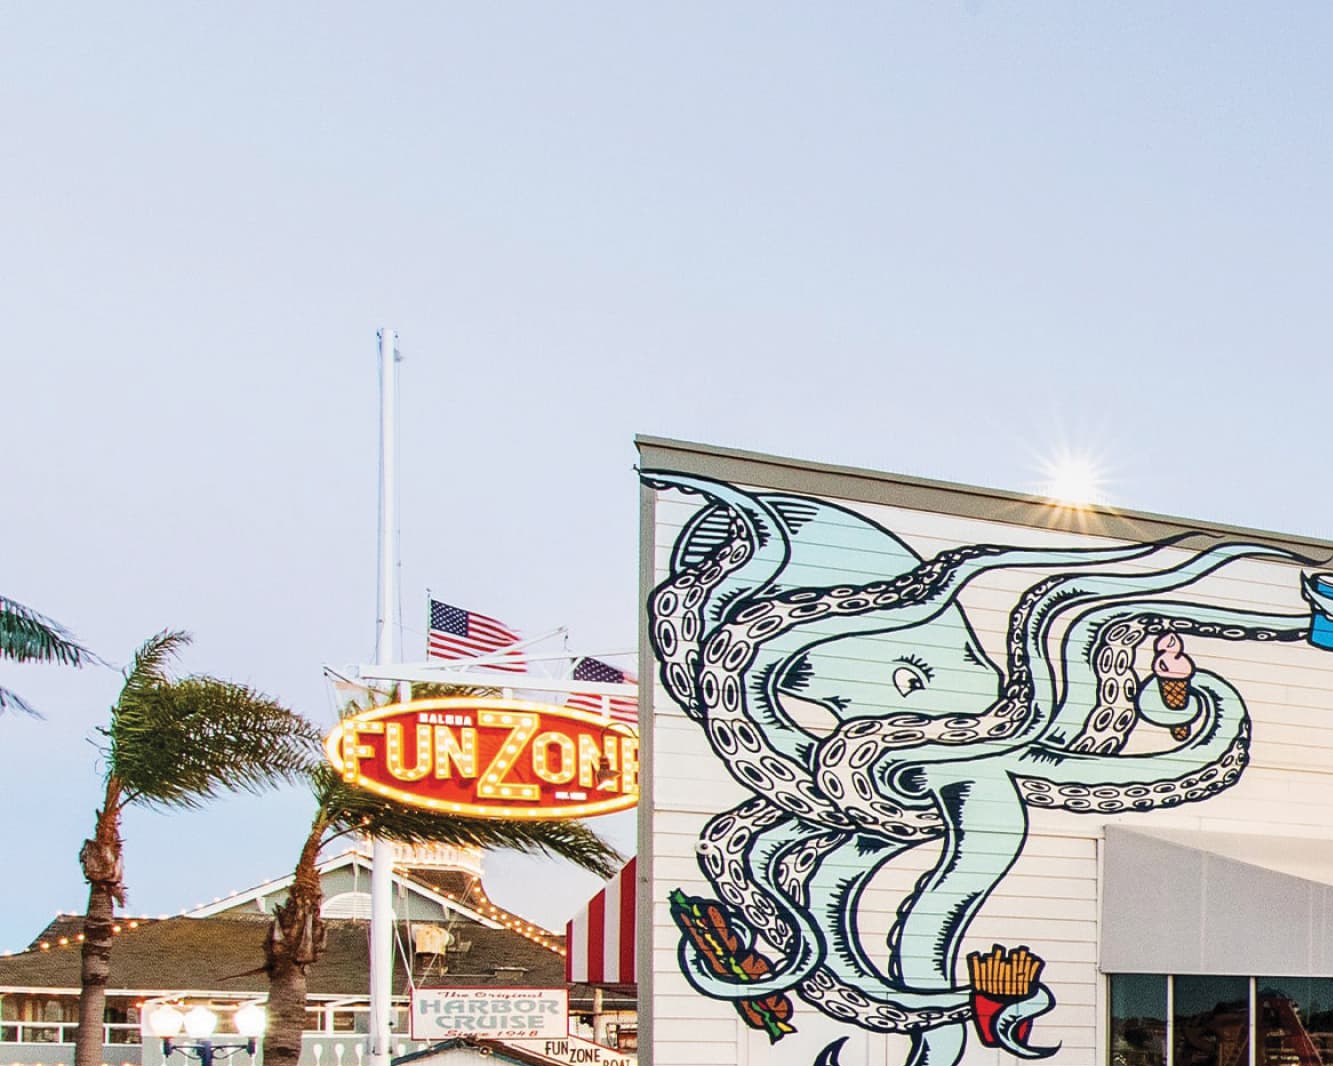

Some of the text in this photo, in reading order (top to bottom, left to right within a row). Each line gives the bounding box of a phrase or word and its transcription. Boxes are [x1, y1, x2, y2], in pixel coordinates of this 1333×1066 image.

[419, 713, 473, 726] BALBOA
[475, 990, 543, 999] Original
[420, 999, 560, 1015] HARBOR
[435, 1014, 544, 1030] CRUISE
[546, 1040, 569, 1057] FUN
[569, 1048, 600, 1063] ZONE
